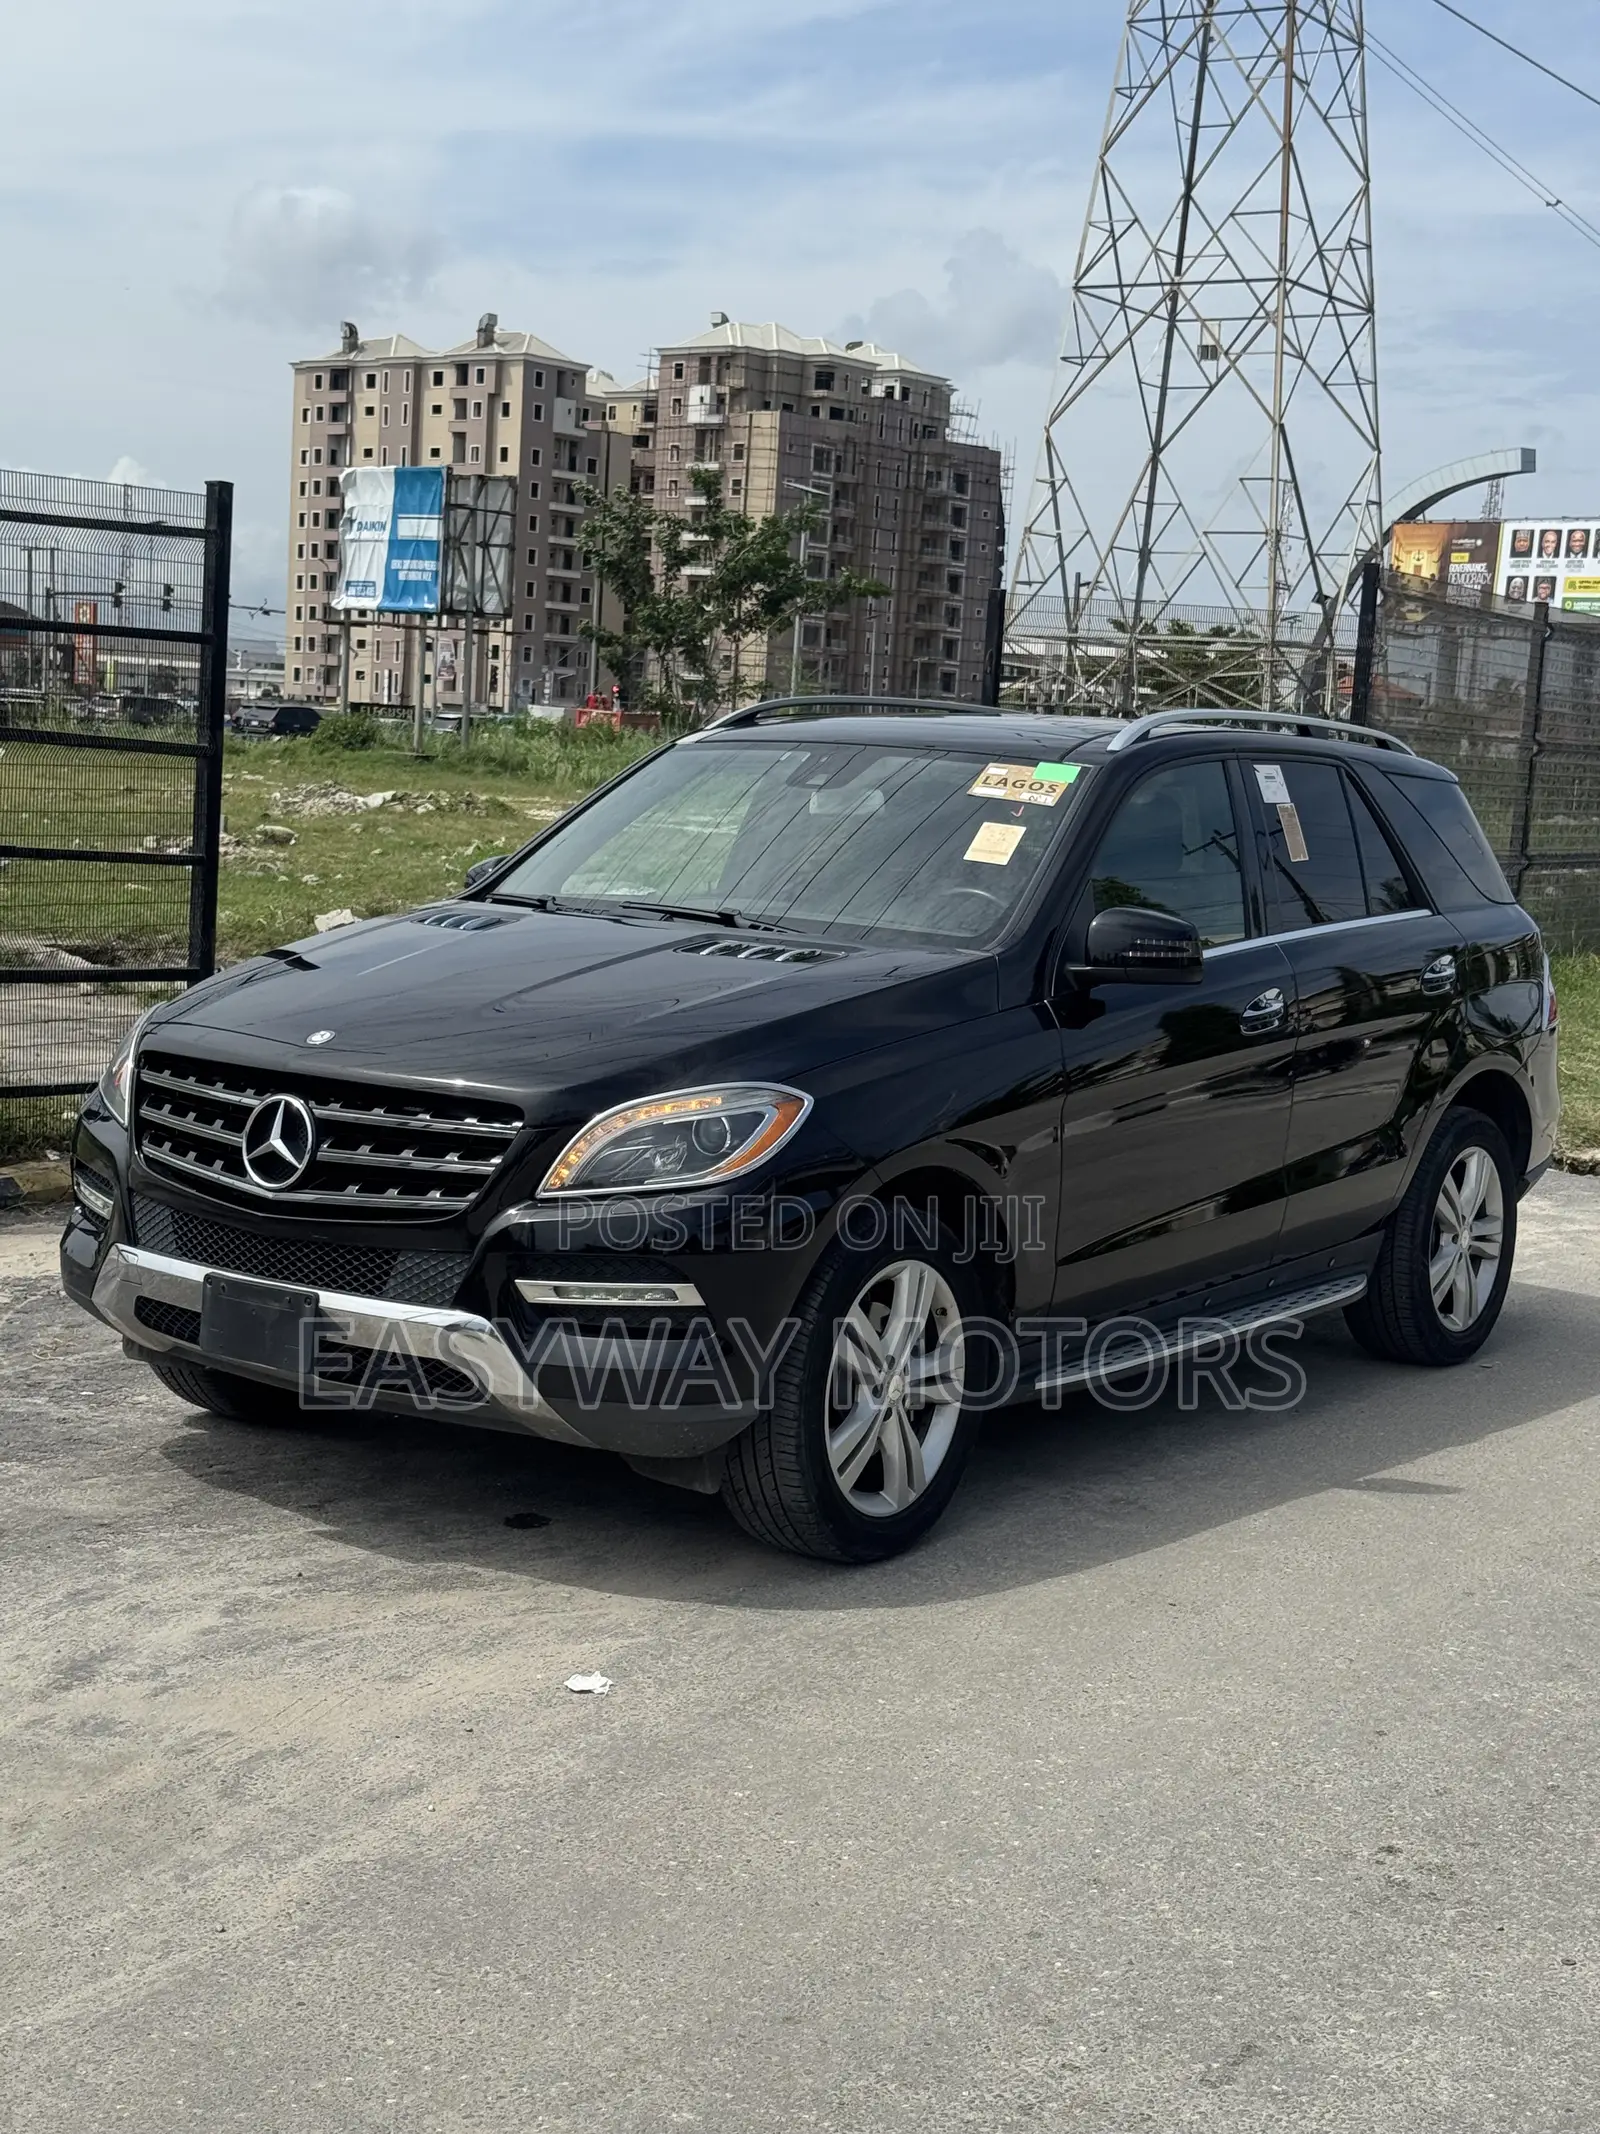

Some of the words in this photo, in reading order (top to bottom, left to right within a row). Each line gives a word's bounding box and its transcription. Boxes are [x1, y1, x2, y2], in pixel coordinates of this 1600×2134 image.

[356, 520, 387, 532] DAIKIN
[1448, 572, 1492, 585] DEMOCRACY
[981, 775, 1060, 794] LAGOS
